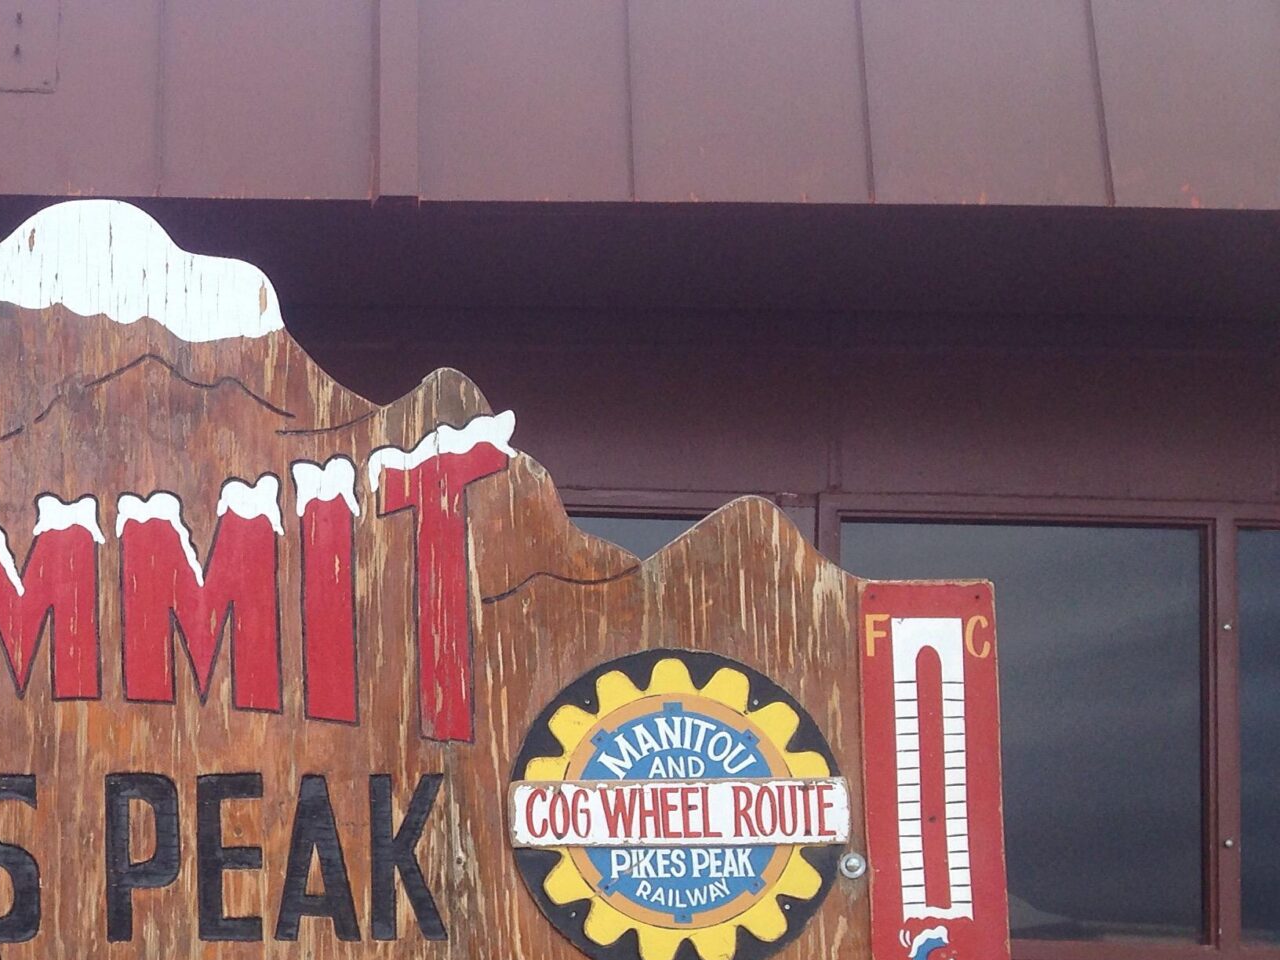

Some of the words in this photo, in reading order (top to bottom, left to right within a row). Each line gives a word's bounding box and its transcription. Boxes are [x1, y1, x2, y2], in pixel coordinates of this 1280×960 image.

[865, 614, 891, 657] F
[964, 615, 991, 659] C
[598, 716, 757, 780] MANITOU
[648, 755, 706, 779] AND
[525, 787, 592, 839] COG
[601, 785, 723, 839] WHEEL
[731, 783, 837, 838] ROUTE
[104, 772, 449, 943] PEAK
[610, 849, 687, 879] PIKES
[692, 848, 756, 879] PEAK
[635, 877, 731, 909] RAILWAY
